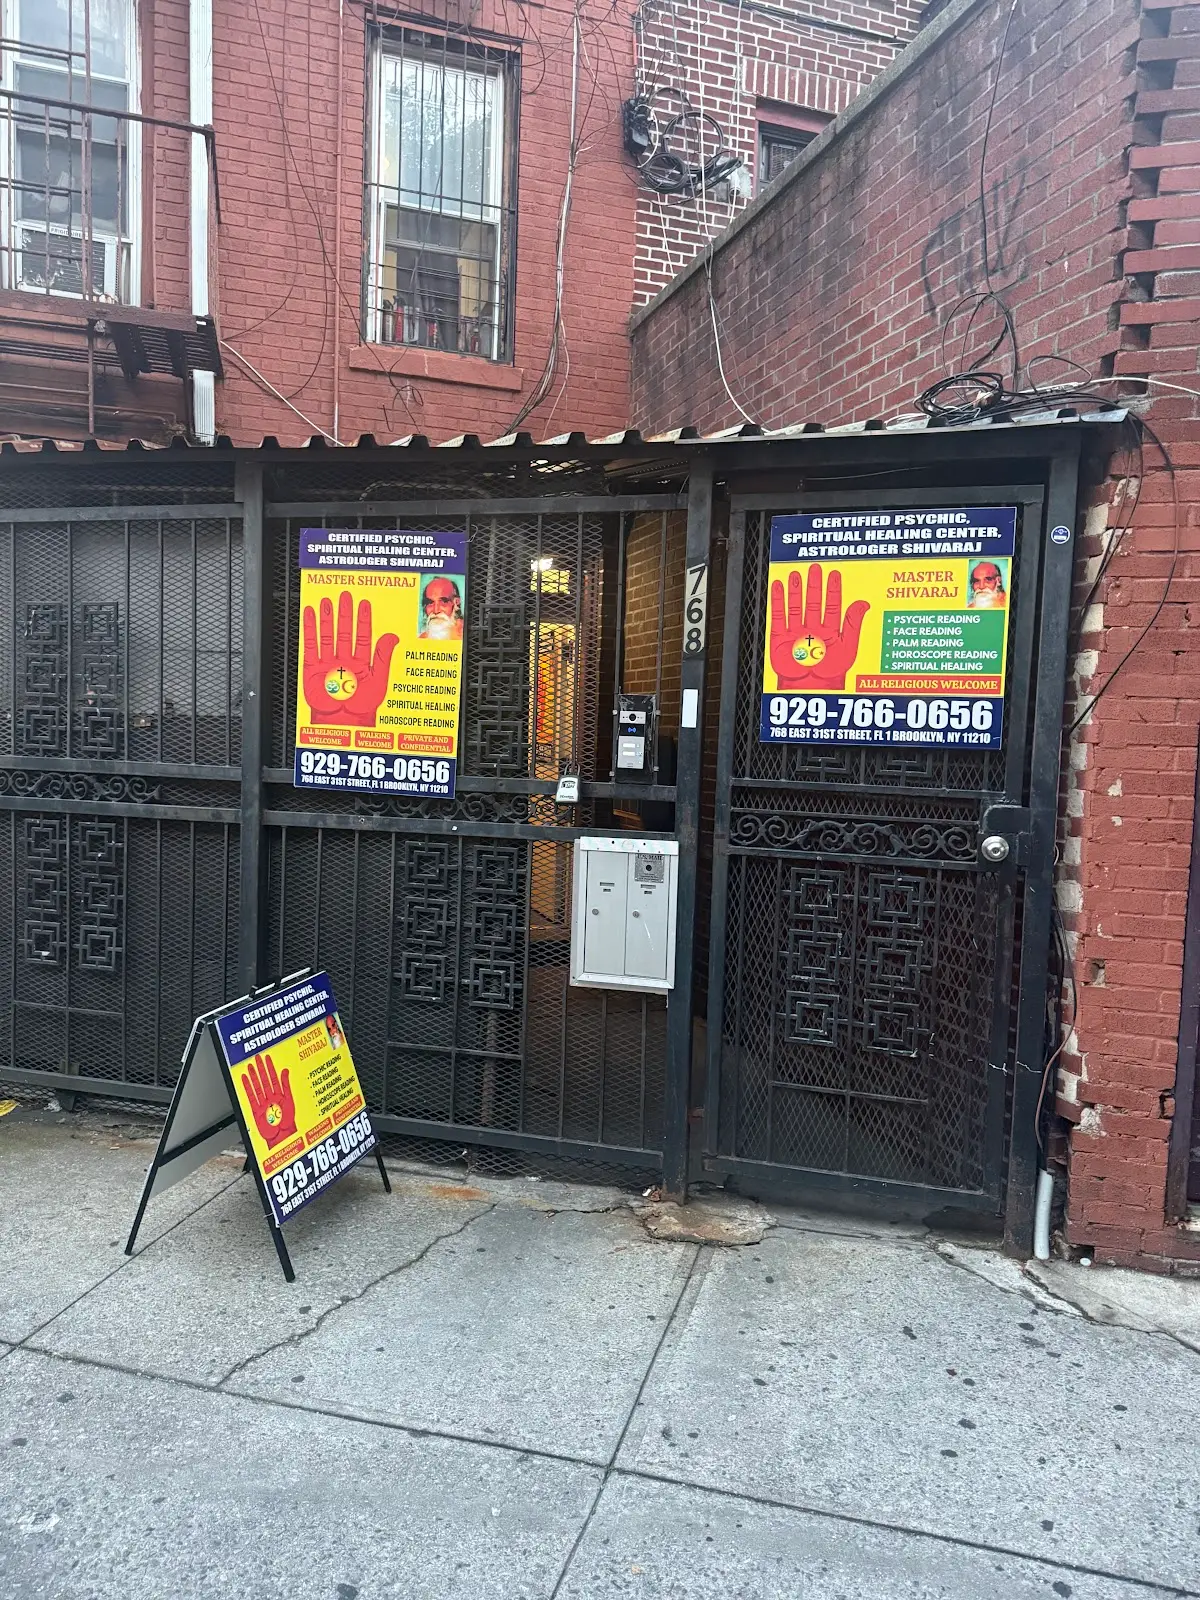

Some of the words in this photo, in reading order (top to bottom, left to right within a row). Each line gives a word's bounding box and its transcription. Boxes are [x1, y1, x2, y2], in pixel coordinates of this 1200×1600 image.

[812, 515, 890, 528] CERTIFIED
[895, 512, 970, 526] PSYCHIC,
[328, 533, 383, 543] CERTIFIED
[384, 535, 436, 545] PSYCHIC,
[782, 530, 862, 544] SPIRITUAL
[864, 528, 932, 541] HEALING
[934, 526, 1002, 540] CENTER,
[308, 544, 362, 554] SPIRITUAL
[365, 546, 410, 555] HEALING
[413, 548, 457, 558] CENTER,
[798, 544, 900, 557] ASTROLOGER
[902, 542, 982, 554] SHIVARAJ
[319, 556, 388, 566] ASTROLOGER
[390, 558, 444, 568] SHIVARAJ
[307, 574, 355, 586] MASTER
[358, 576, 416, 588] SHIVARAJ
[893, 570, 954, 583] MASTER
[886, 586, 958, 599] SHIVARAJ
[685, 566, 706, 654] 768
[894, 616, 936, 624] PSYCHIC
[938, 615, 980, 624] READING
[893, 628, 917, 636] FACE
[919, 628, 962, 636] READING
[893, 639, 918, 647] PALM
[921, 639, 964, 648] READING
[405, 651, 426, 660] PALM
[426, 652, 458, 662] READING
[892, 651, 953, 659] HOROSCOPE
[954, 651, 998, 659] READING
[406, 668, 424, 676] FACE
[426, 668, 457, 678] READING
[890, 663, 938, 671] SPIRITUAL
[940, 662, 983, 671] HEALING
[393, 684, 424, 694] PSYCHIC
[425, 685, 456, 695] READING
[859, 680, 878, 688] ALL
[881, 680, 938, 689] RELIGIOUS
[940, 681, 998, 690] WELCOME
[387, 700, 423, 710] SPIRITUAL
[425, 702, 456, 712] HEALING
[770, 697, 993, 730] 929-766-0656
[380, 716, 422, 726] HOROSCOPE
[424, 718, 454, 728] READING
[314, 728, 350, 737] RELIGIOUS
[360, 732, 390, 740] WALKINS
[404, 734, 431, 743] PRIVATE
[432, 736, 448, 744] AND
[770, 727, 787, 737] 768
[789, 728, 812, 738] EAST
[813, 728, 836, 739] 31ST
[837, 729, 872, 740] STREET,
[874, 730, 884, 740] FL
[886, 730, 890, 740] 1
[892, 730, 945, 743] BROOKLYN,
[947, 732, 961, 743] NY
[962, 733, 990, 744] 11210
[309, 736, 342, 744] WELCOME
[358, 740, 392, 748] WELCOME
[400, 743, 450, 752] CONFIDENTIAL
[300, 751, 450, 784] 929-766-0656
[301, 774, 314, 782] 768
[314, 776, 330, 785] EAST
[330, 777, 346, 786] 31ST
[347, 778, 372, 788] STREET,
[372, 780, 379, 788] FL
[384, 781, 419, 792] BROOKLYN,
[420, 784, 429, 792] NY
[430, 784, 448, 794] 11210
[243, 998, 284, 1024] CERTIFIED
[284, 984, 315, 1005] PSYCHIC,
[230, 1015, 274, 1045] SPIRITUAL
[275, 1002, 304, 1023] HEALING
[304, 990, 330, 1009] CENTER,
[244, 1020, 296, 1053] ASTROLOGER
[295, 1004, 326, 1027] SHIVARAJ
[297, 1027, 323, 1047] MASTER
[299, 1038, 328, 1061] SHIVARAJ
[309, 1064, 326, 1078] PSYCHIC
[326, 1054, 341, 1068] READING
[312, 1076, 322, 1088] FACE
[322, 1066, 338, 1080] READING
[315, 1085, 326, 1097] PALM
[326, 1075, 342, 1089] READING
[318, 1086, 340, 1106] HOROSCOPE
[340, 1076, 355, 1090] READING
[321, 1099, 339, 1115] SPIRITUAL
[339, 1087, 354, 1102] HEALING
[272, 1111, 372, 1203] 929-766-0656
[281, 1199, 292, 1216] 768
[291, 1192, 305, 1208] EAST
[304, 1183, 317, 1198] 31ST
